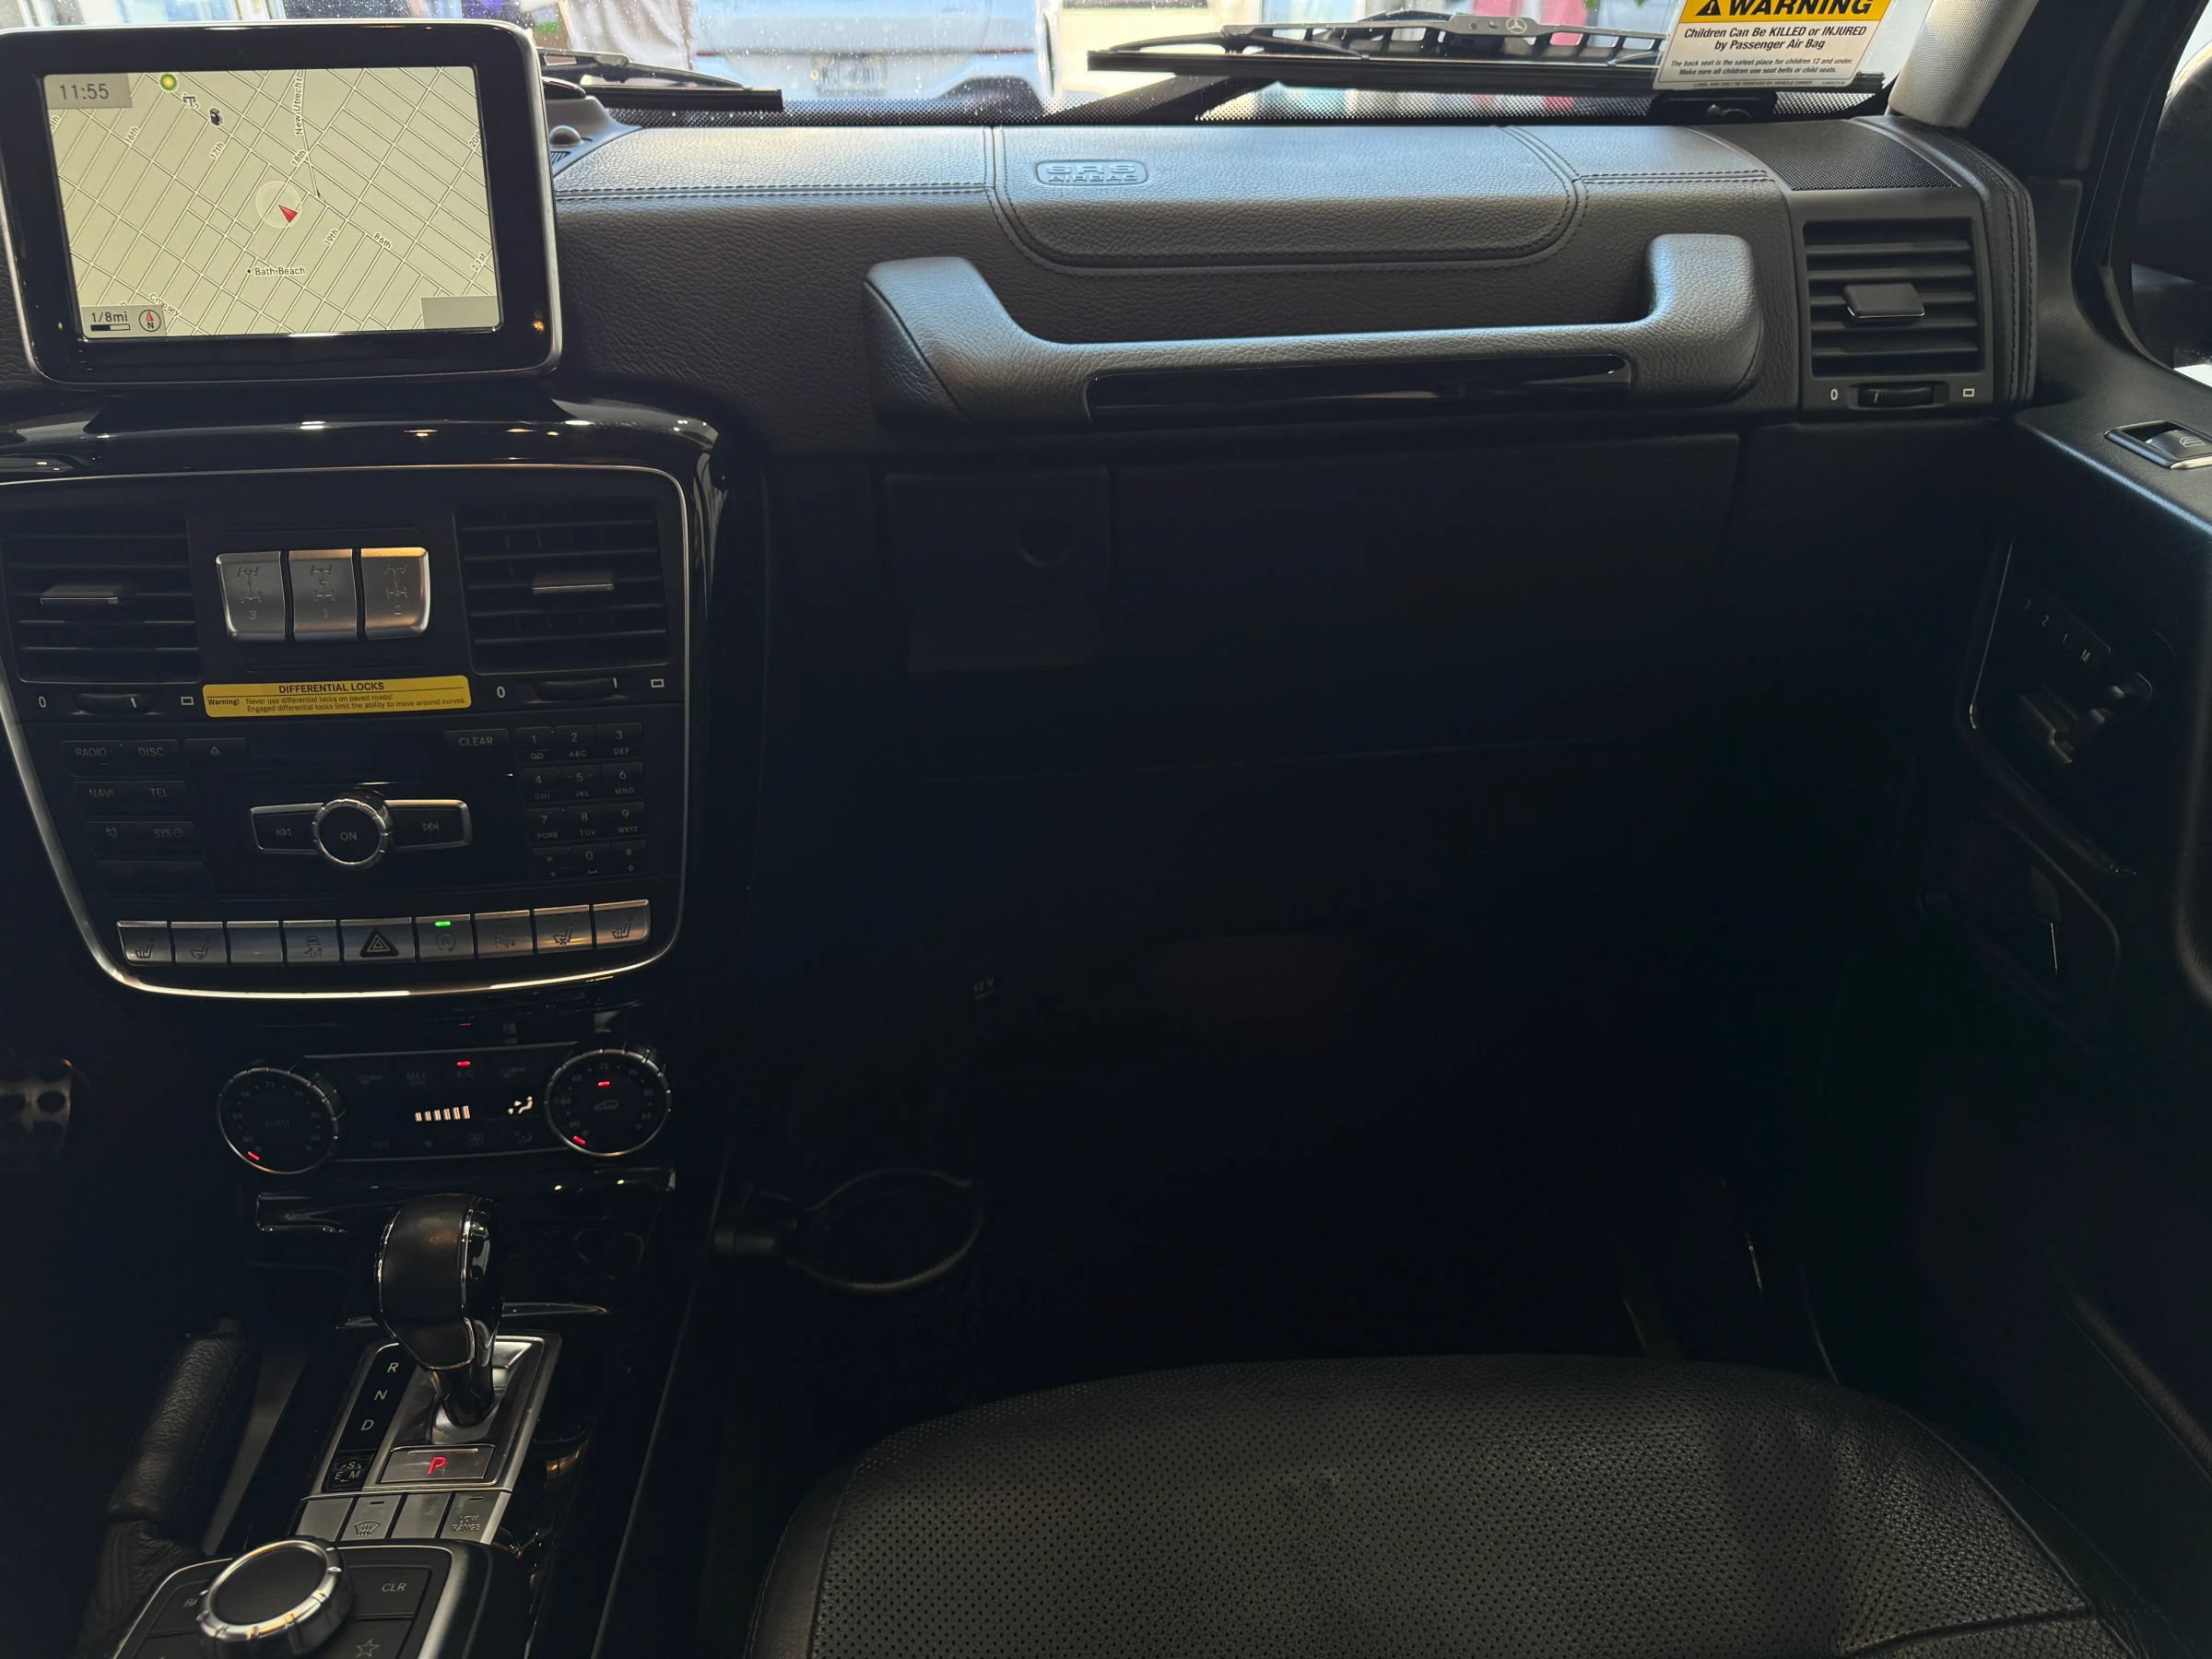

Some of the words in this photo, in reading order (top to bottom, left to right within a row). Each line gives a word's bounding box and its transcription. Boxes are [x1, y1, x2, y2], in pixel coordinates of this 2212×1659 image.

[1729, 0, 1872, 15] WARNING
[1685, 28, 1726, 38] Children
[1729, 28, 1749, 37] Can
[1752, 28, 1766, 37] Be
[1769, 27, 1806, 36] KILLED
[1808, 28, 1820, 36] or
[1822, 26, 1866, 36] INJURED
[1714, 41, 1728, 52] by
[1730, 39, 1785, 51] Passenger
[1787, 39, 1803, 49] Air
[1805, 39, 1825, 50] Bag
[59, 83, 110, 100] 11:55
[293, 77, 303, 112] Utrecht
[125, 125, 140, 144] 16th
[210, 142, 225, 159] 17th
[291, 150, 306, 166] 18th
[1045, 165, 1135, 174] SRS
[1048, 174, 1138, 182] AIRBAG
[325, 229, 339, 246] 19th
[373, 231, 392, 249] 86th
[471, 253, 487, 271] 21st
[254, 266, 276, 276] Bath
[278, 265, 306, 275] Beach
[149, 293, 181, 316] Cropsey
[90, 312, 128, 323] 1/8mi
[279, 683, 348, 693] DIFFERENTIAL
[351, 682, 384, 691] LOCKS
[207, 698, 240, 706] Warning!
[350, 694, 370, 702] paved
[247, 705, 276, 713] Engaged
[365, 700, 384, 709] ability
[571, 732, 578, 742] 2
[616, 730, 623, 739] 3
[459, 736, 494, 746] CLEAR
[75, 747, 107, 757] RADIO
[138, 747, 164, 757] DISC
[569, 749, 587, 759] ABC
[535, 775, 543, 784] 4
[618, 770, 627, 780] 6
[88, 788, 114, 797] NAVI
[149, 788, 169, 797] TEL
[615, 787, 635, 795] MNO
[581, 812, 589, 823] 8
[621, 809, 629, 818] 9
[540, 815, 548, 825] 7
[339, 831, 358, 841] ON
[585, 851, 594, 861] 0
[386, 1362, 399, 1372] R
[374, 1389, 388, 1400] N
[360, 1419, 374, 1430] D
[347, 1462, 356, 1470] S
[428, 1456, 448, 1475] P
[335, 1471, 342, 1480] E
[348, 1470, 360, 1478] M
[452, 1524, 481, 1532] RANGE
[382, 1583, 406, 1593] CLR
